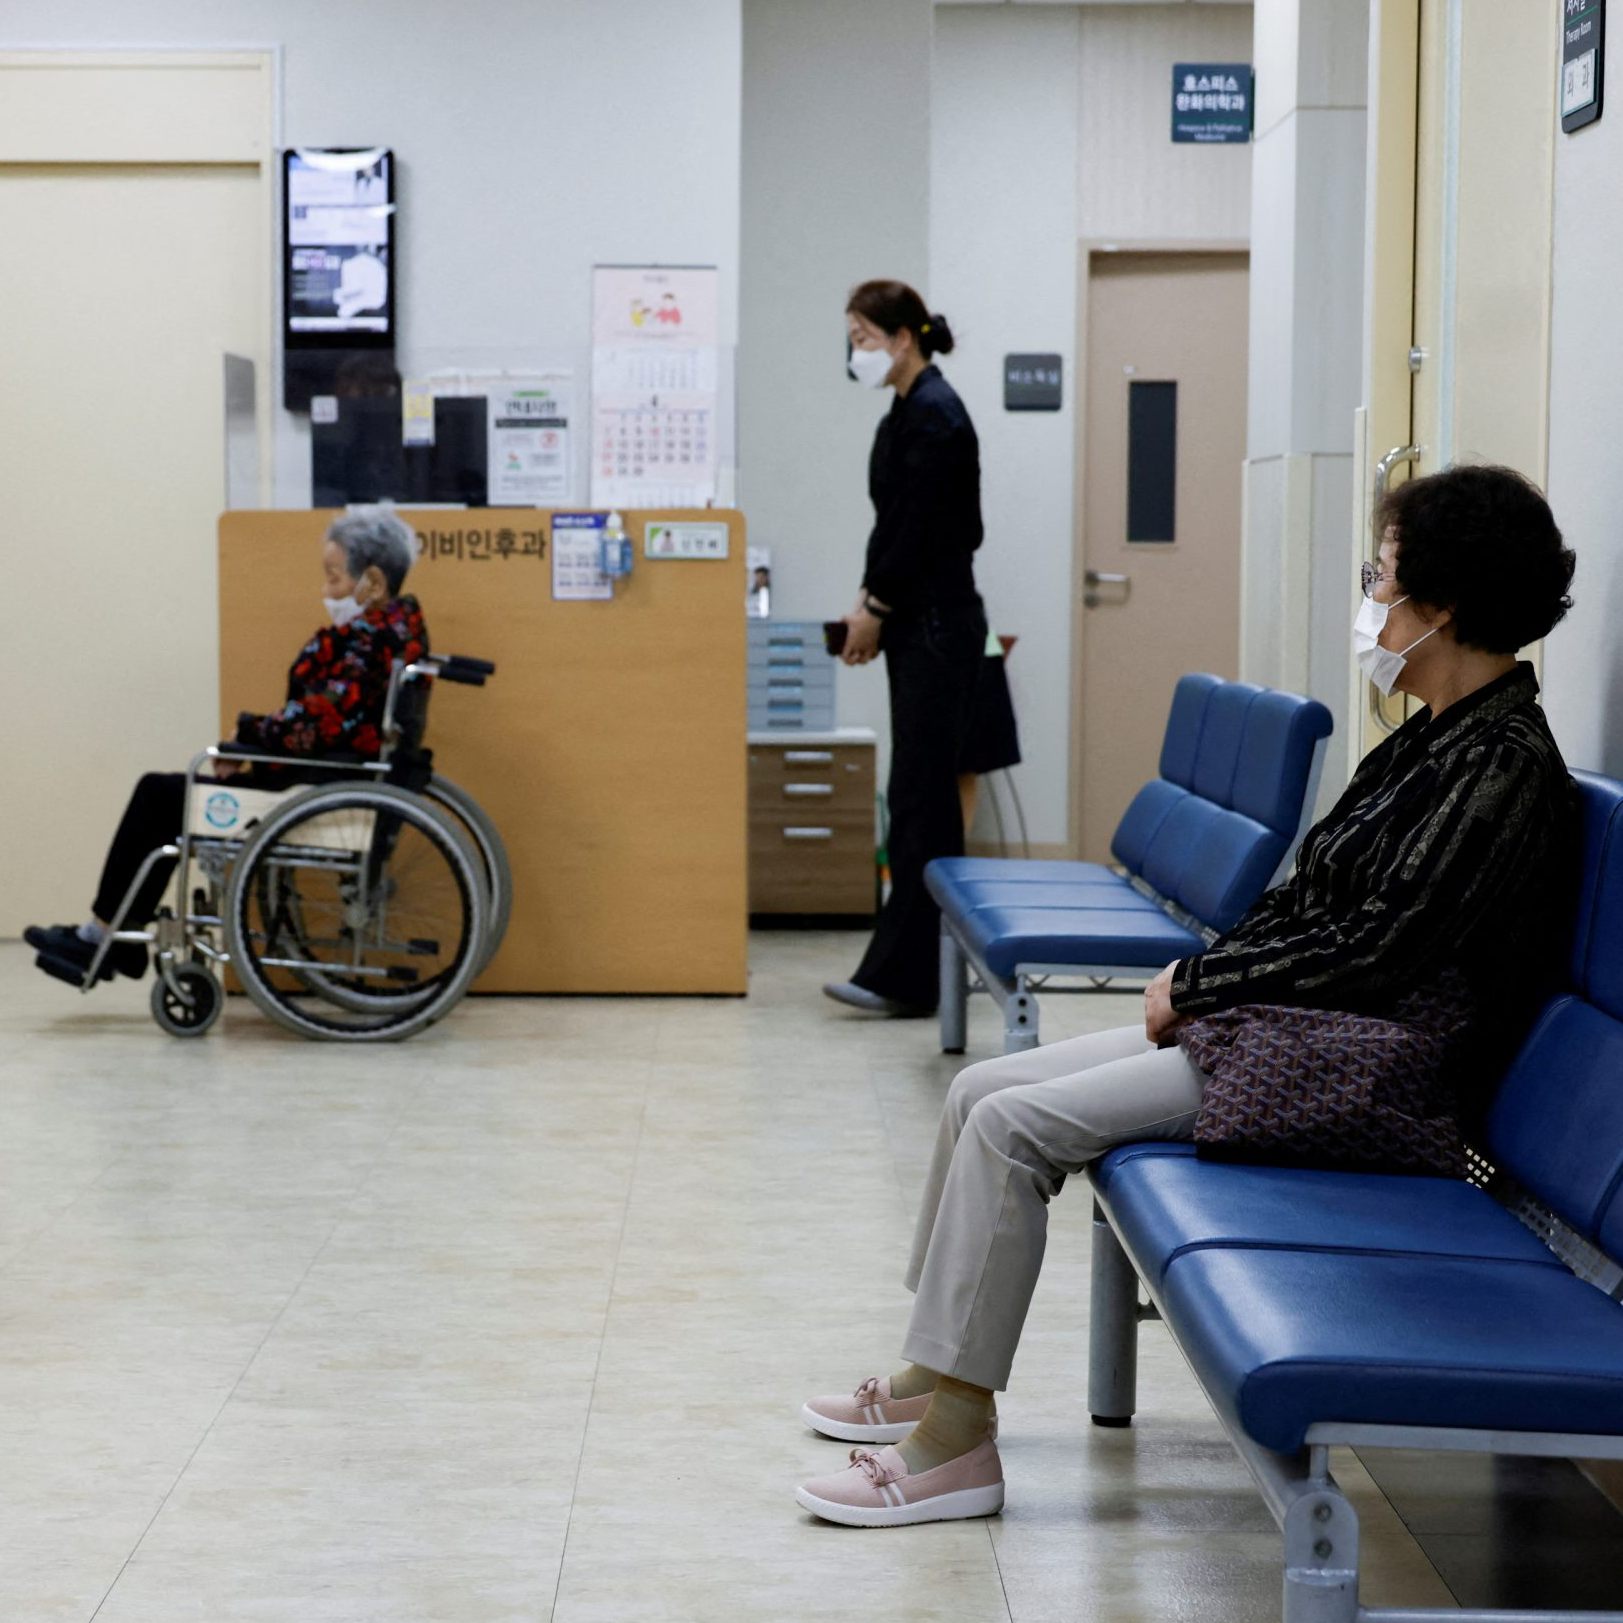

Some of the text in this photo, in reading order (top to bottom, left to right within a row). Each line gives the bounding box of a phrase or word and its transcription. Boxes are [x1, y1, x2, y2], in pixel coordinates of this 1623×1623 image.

[1565, 20, 1592, 45] Therapy Room
[415, 528, 546, 561] 이비인후과
